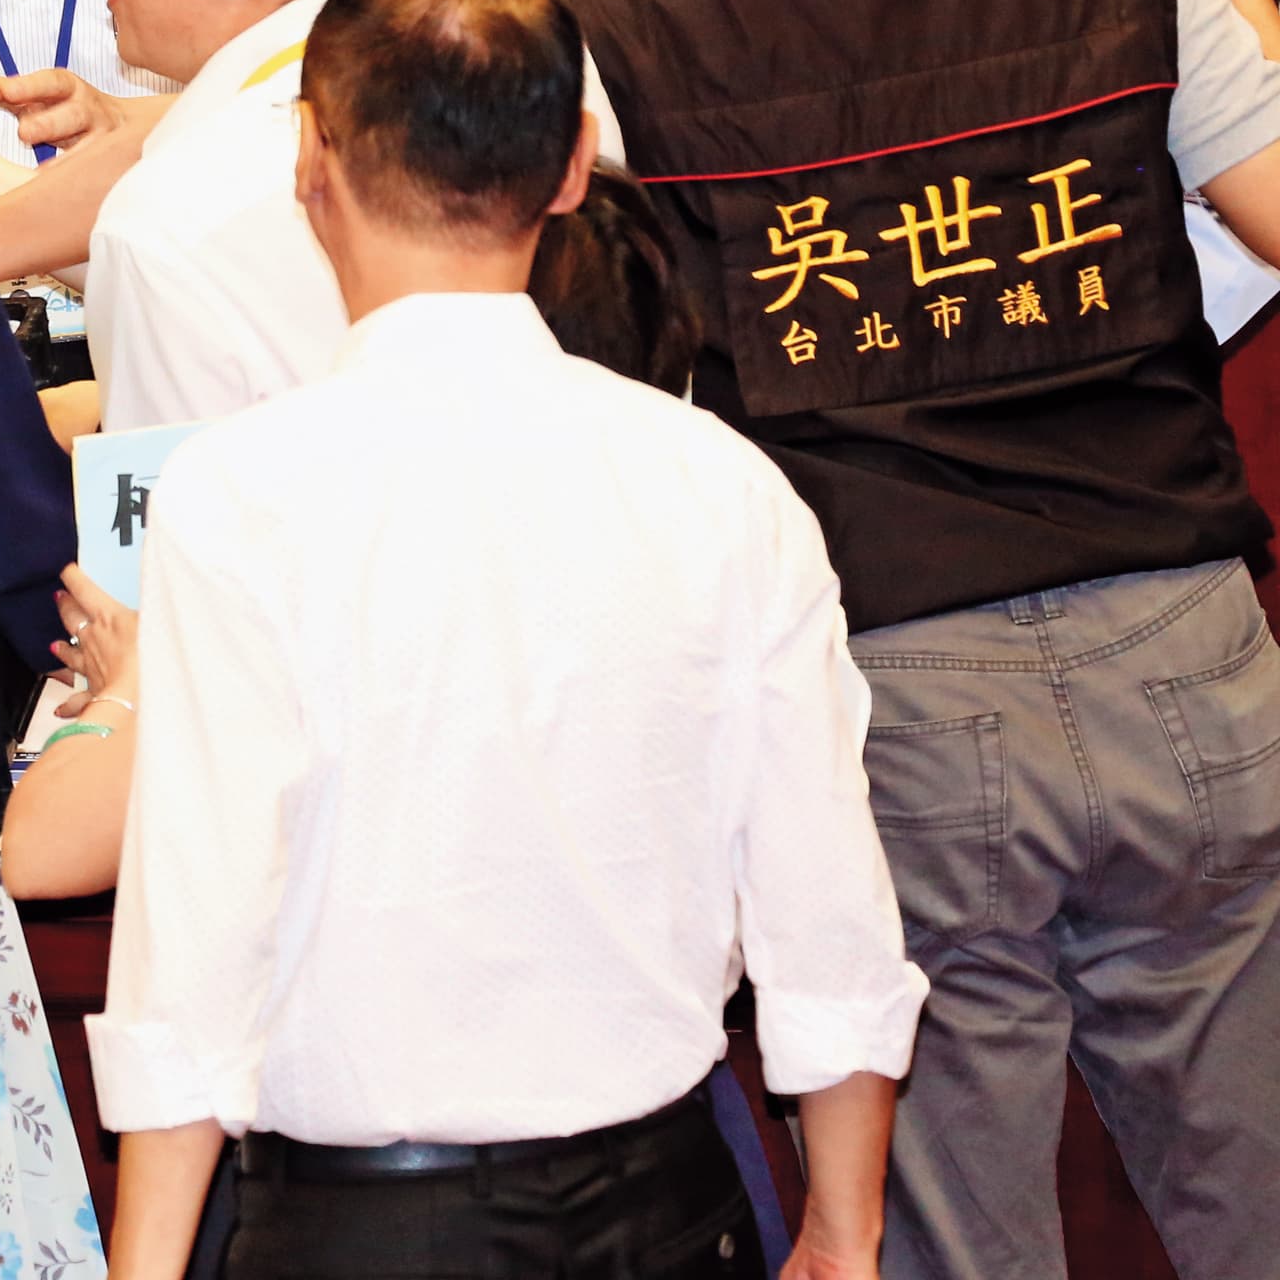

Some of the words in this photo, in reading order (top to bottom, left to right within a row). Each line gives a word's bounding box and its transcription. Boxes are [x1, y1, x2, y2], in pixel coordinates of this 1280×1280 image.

[751, 158, 1123, 314] 吳世正
[780, 265, 1110, 366] 台北市議員
